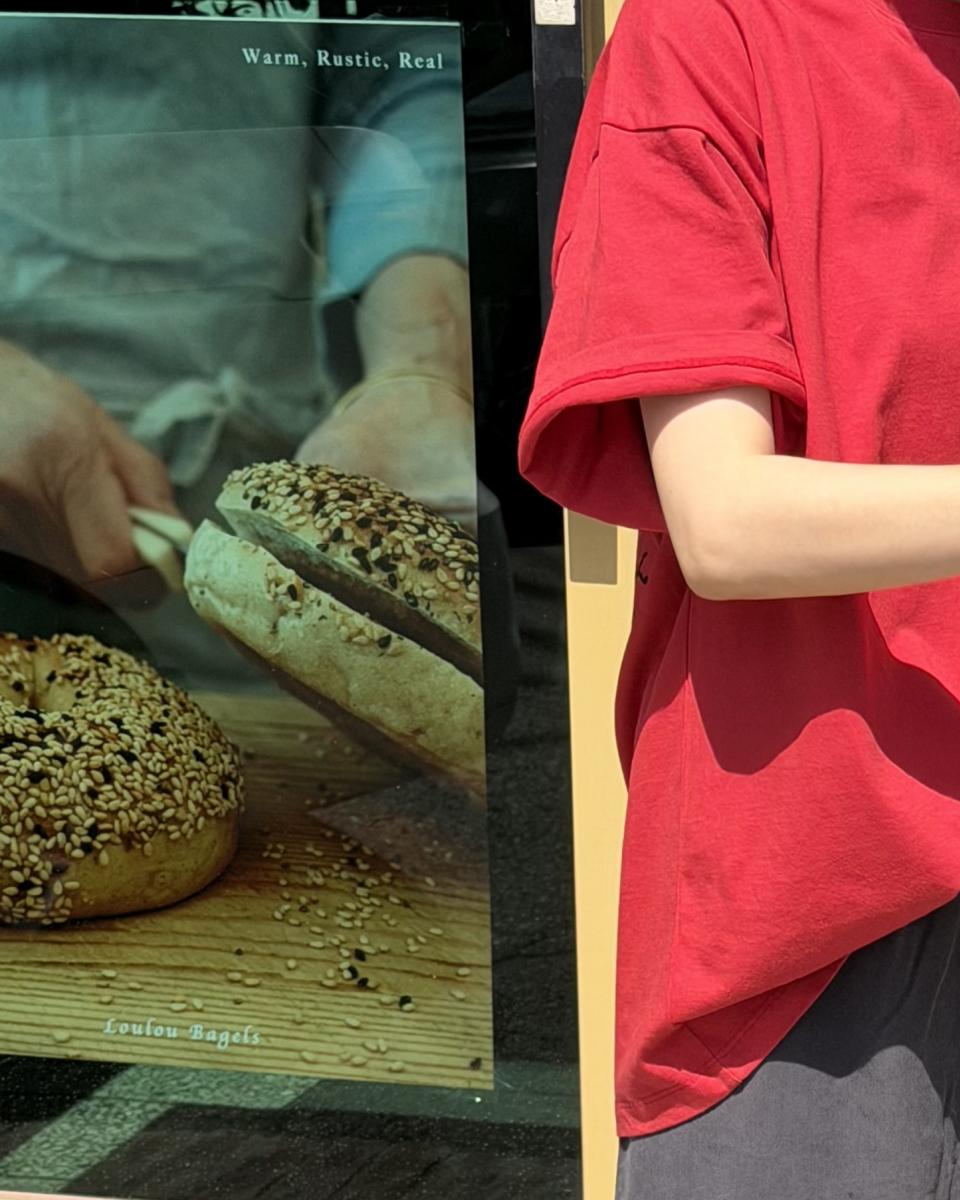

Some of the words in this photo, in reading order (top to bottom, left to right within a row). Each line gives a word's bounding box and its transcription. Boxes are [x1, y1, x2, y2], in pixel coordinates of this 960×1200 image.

[241, 48, 308, 68] Warm,
[317, 49, 389, 70] Rustic,
[399, 52, 443, 69] Real
[103, 1017, 178, 1038] Loulou
[188, 1025, 262, 1050] Bagels
